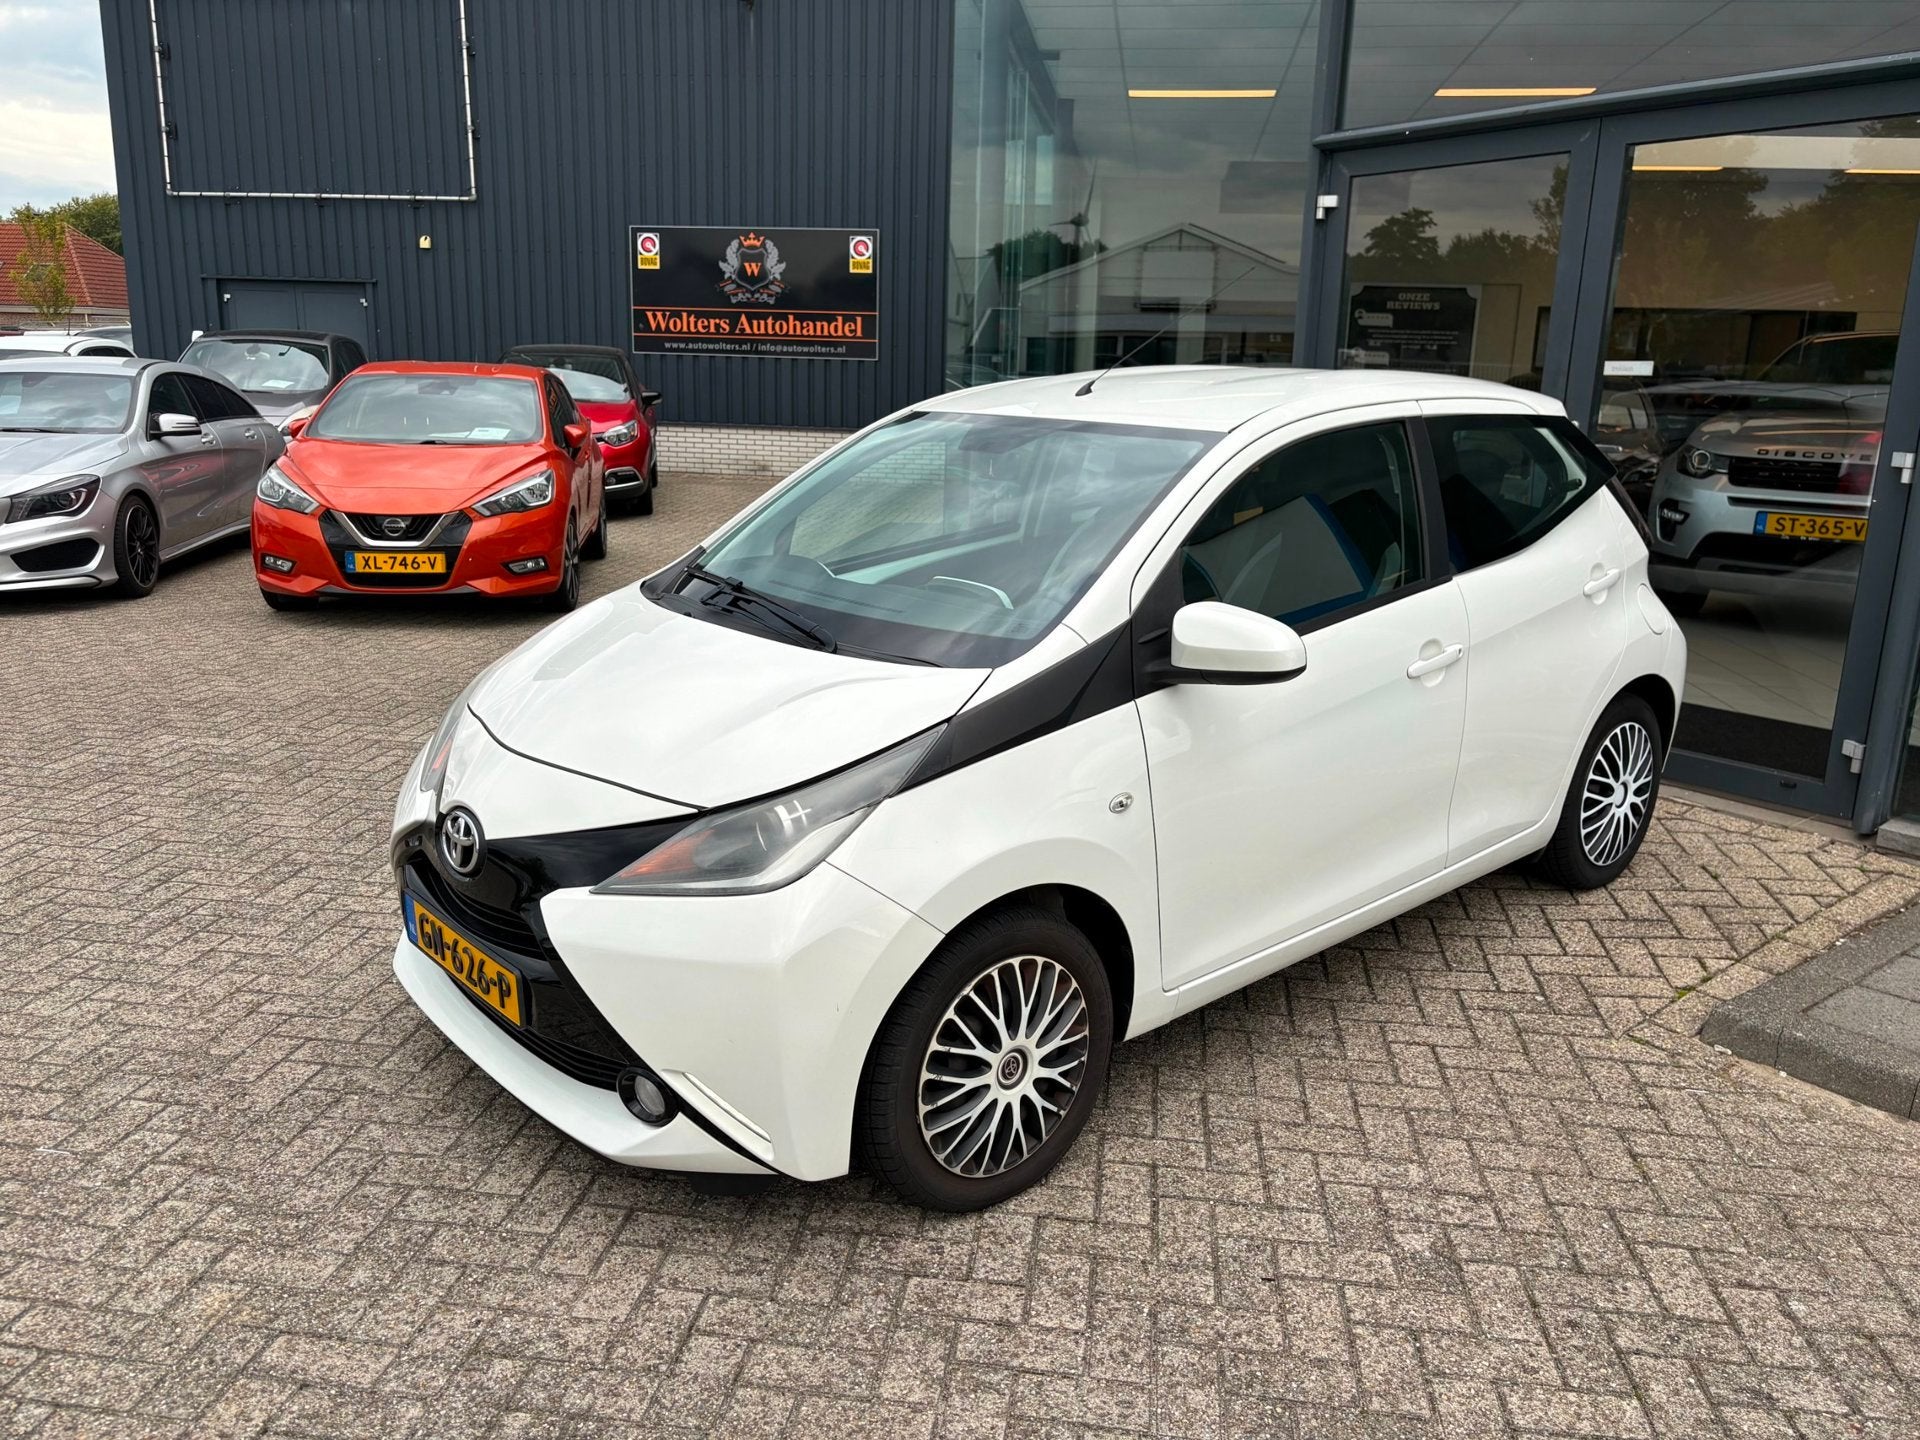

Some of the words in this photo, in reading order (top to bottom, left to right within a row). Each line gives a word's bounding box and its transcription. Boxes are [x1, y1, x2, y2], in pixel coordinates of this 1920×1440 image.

[640, 257, 658, 267] BOVAG
[852, 260, 871, 270] BOVAG
[743, 262, 762, 277] W
[1398, 292, 1431, 301] ONZE
[1386, 301, 1441, 310] REVIEWS
[645, 311, 730, 334] Wolters
[735, 313, 863, 337] Autohandel
[664, 342, 750, 351] www.autowolters.nl
[758, 343, 846, 353] info@autowolters.nl
[1757, 448, 1873, 461] DISCOVE
[1774, 516, 1866, 538] ST-365-V
[362, 556, 437, 570] XL-746-V
[418, 912, 511, 1009] GN-626-P
